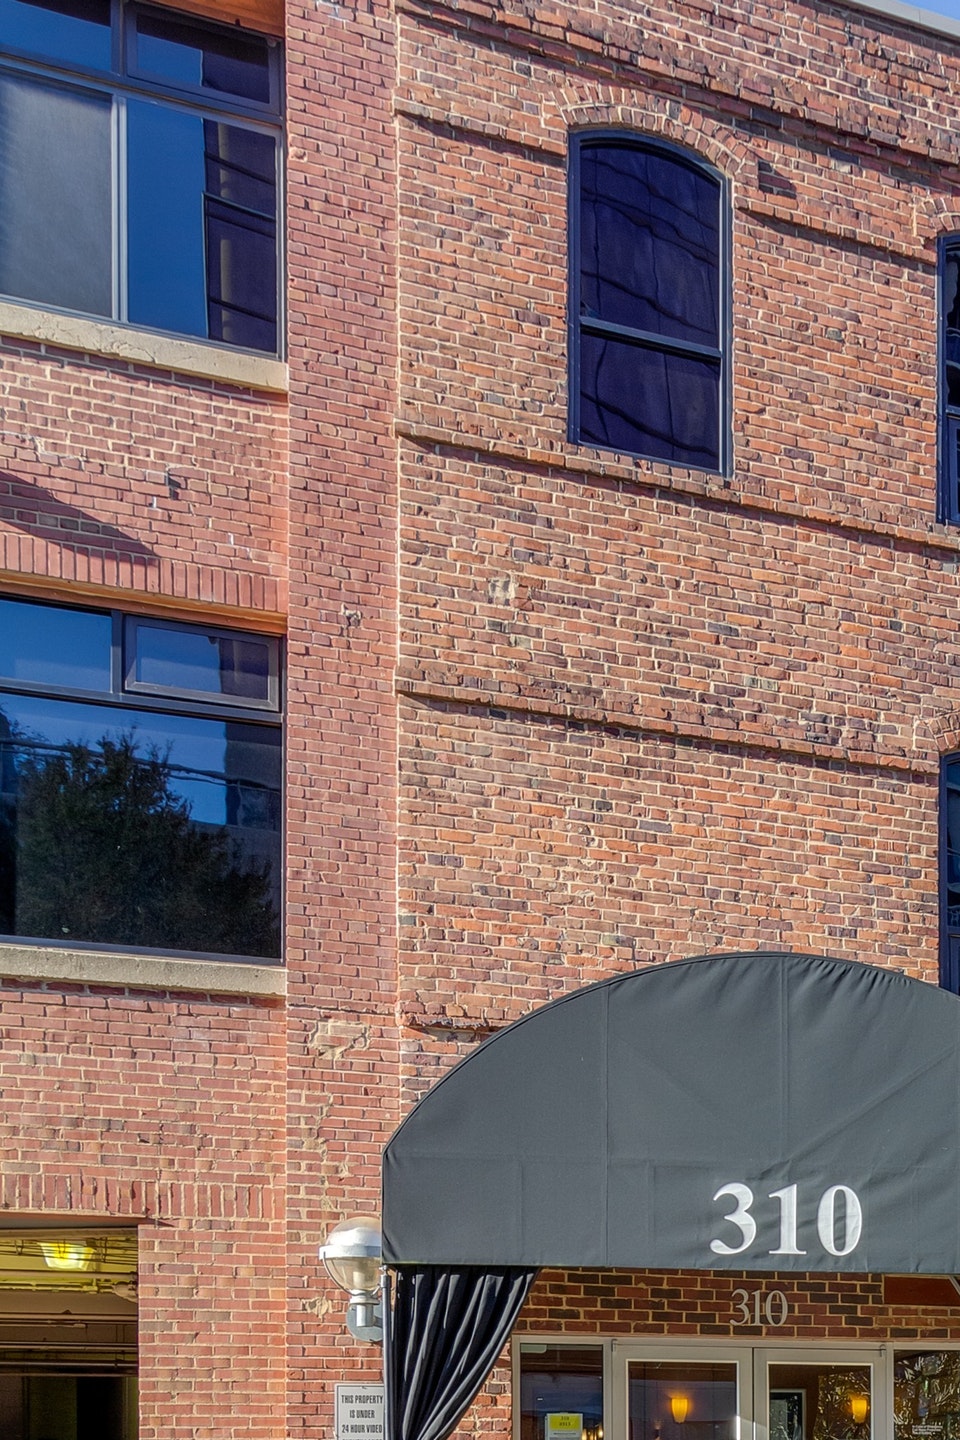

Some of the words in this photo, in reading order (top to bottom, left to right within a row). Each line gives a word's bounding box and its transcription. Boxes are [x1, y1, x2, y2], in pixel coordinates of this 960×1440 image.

[709, 1182, 862, 1256] 310
[729, 1289, 789, 1327] 310
[341, 1394, 354, 1404] THIS
[355, 1394, 383, 1404] PROPERTY
[349, 1409, 356, 1419] IS
[356, 1409, 375, 1419] UNDER
[341, 1424, 349, 1434] 24
[350, 1424, 365, 1433] HOUR
[366, 1424, 383, 1433] VIDEO
